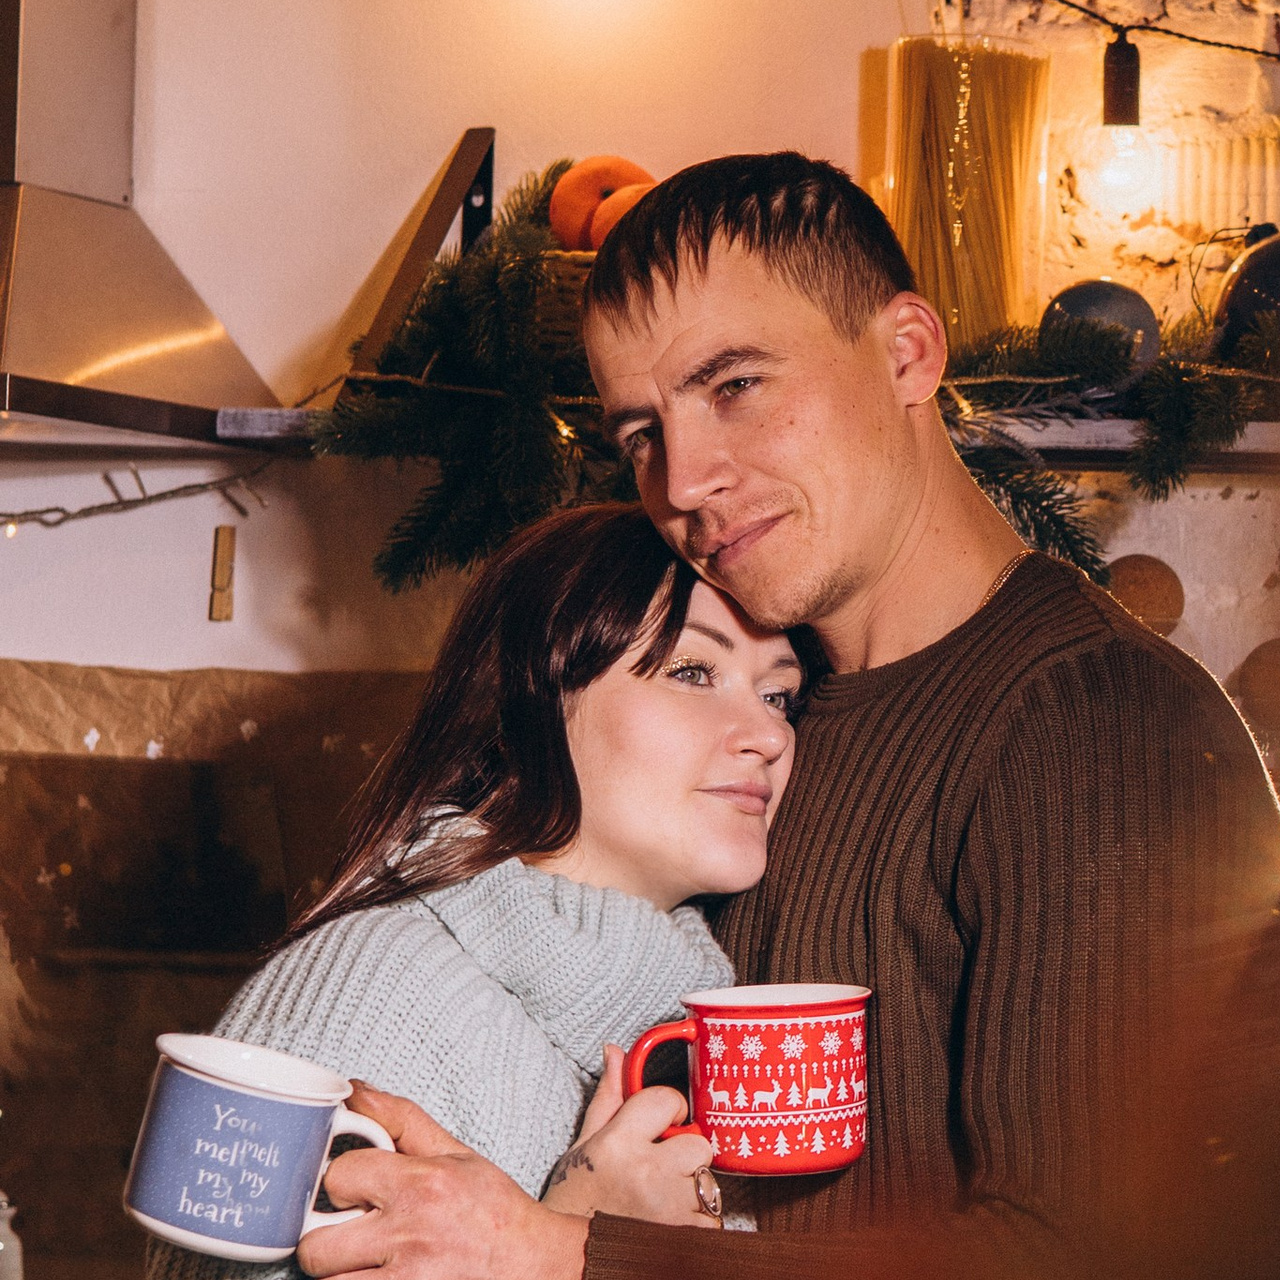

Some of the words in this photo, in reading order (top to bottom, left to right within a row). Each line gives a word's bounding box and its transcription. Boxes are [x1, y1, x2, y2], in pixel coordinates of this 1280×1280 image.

[213, 1104, 257, 1133] You
[240, 1138, 280, 1167] melt
[240, 1169, 270, 1198] my
[178, 1186, 244, 1227] heart
